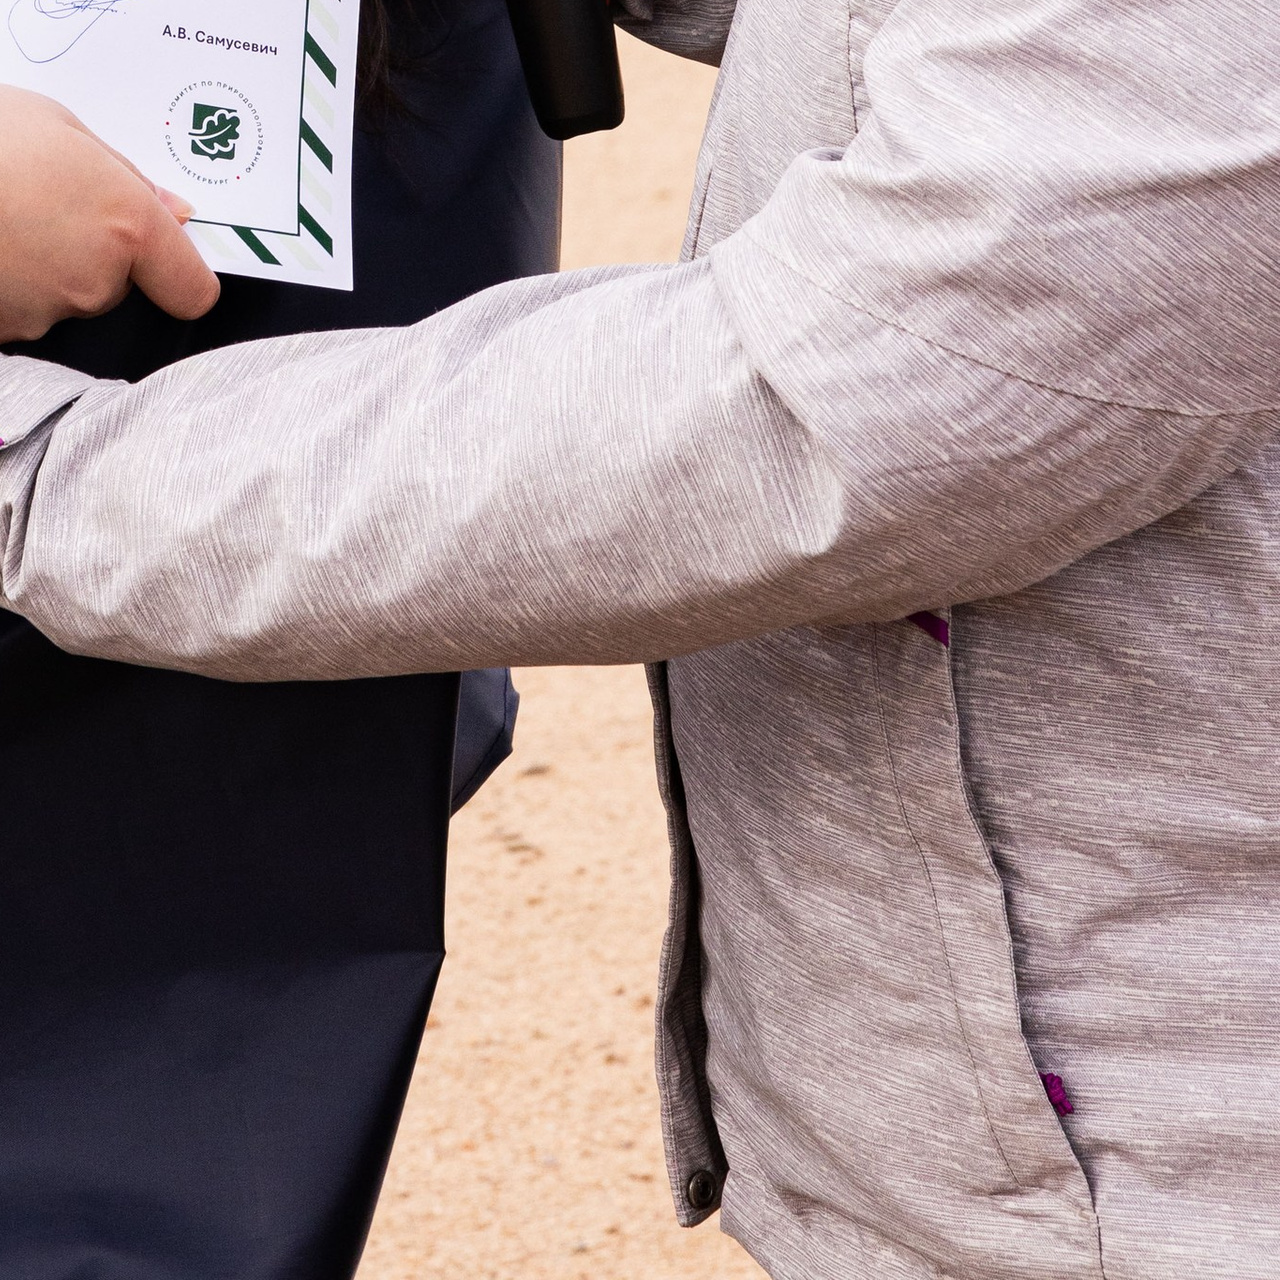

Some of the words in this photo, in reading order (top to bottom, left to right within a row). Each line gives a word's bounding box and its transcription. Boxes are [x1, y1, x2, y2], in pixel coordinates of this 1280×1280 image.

[162, 24, 191, 41] А.В.
[195, 30, 278, 56] Самусевич
[168, 82, 198, 113] КОМИТЕТ
